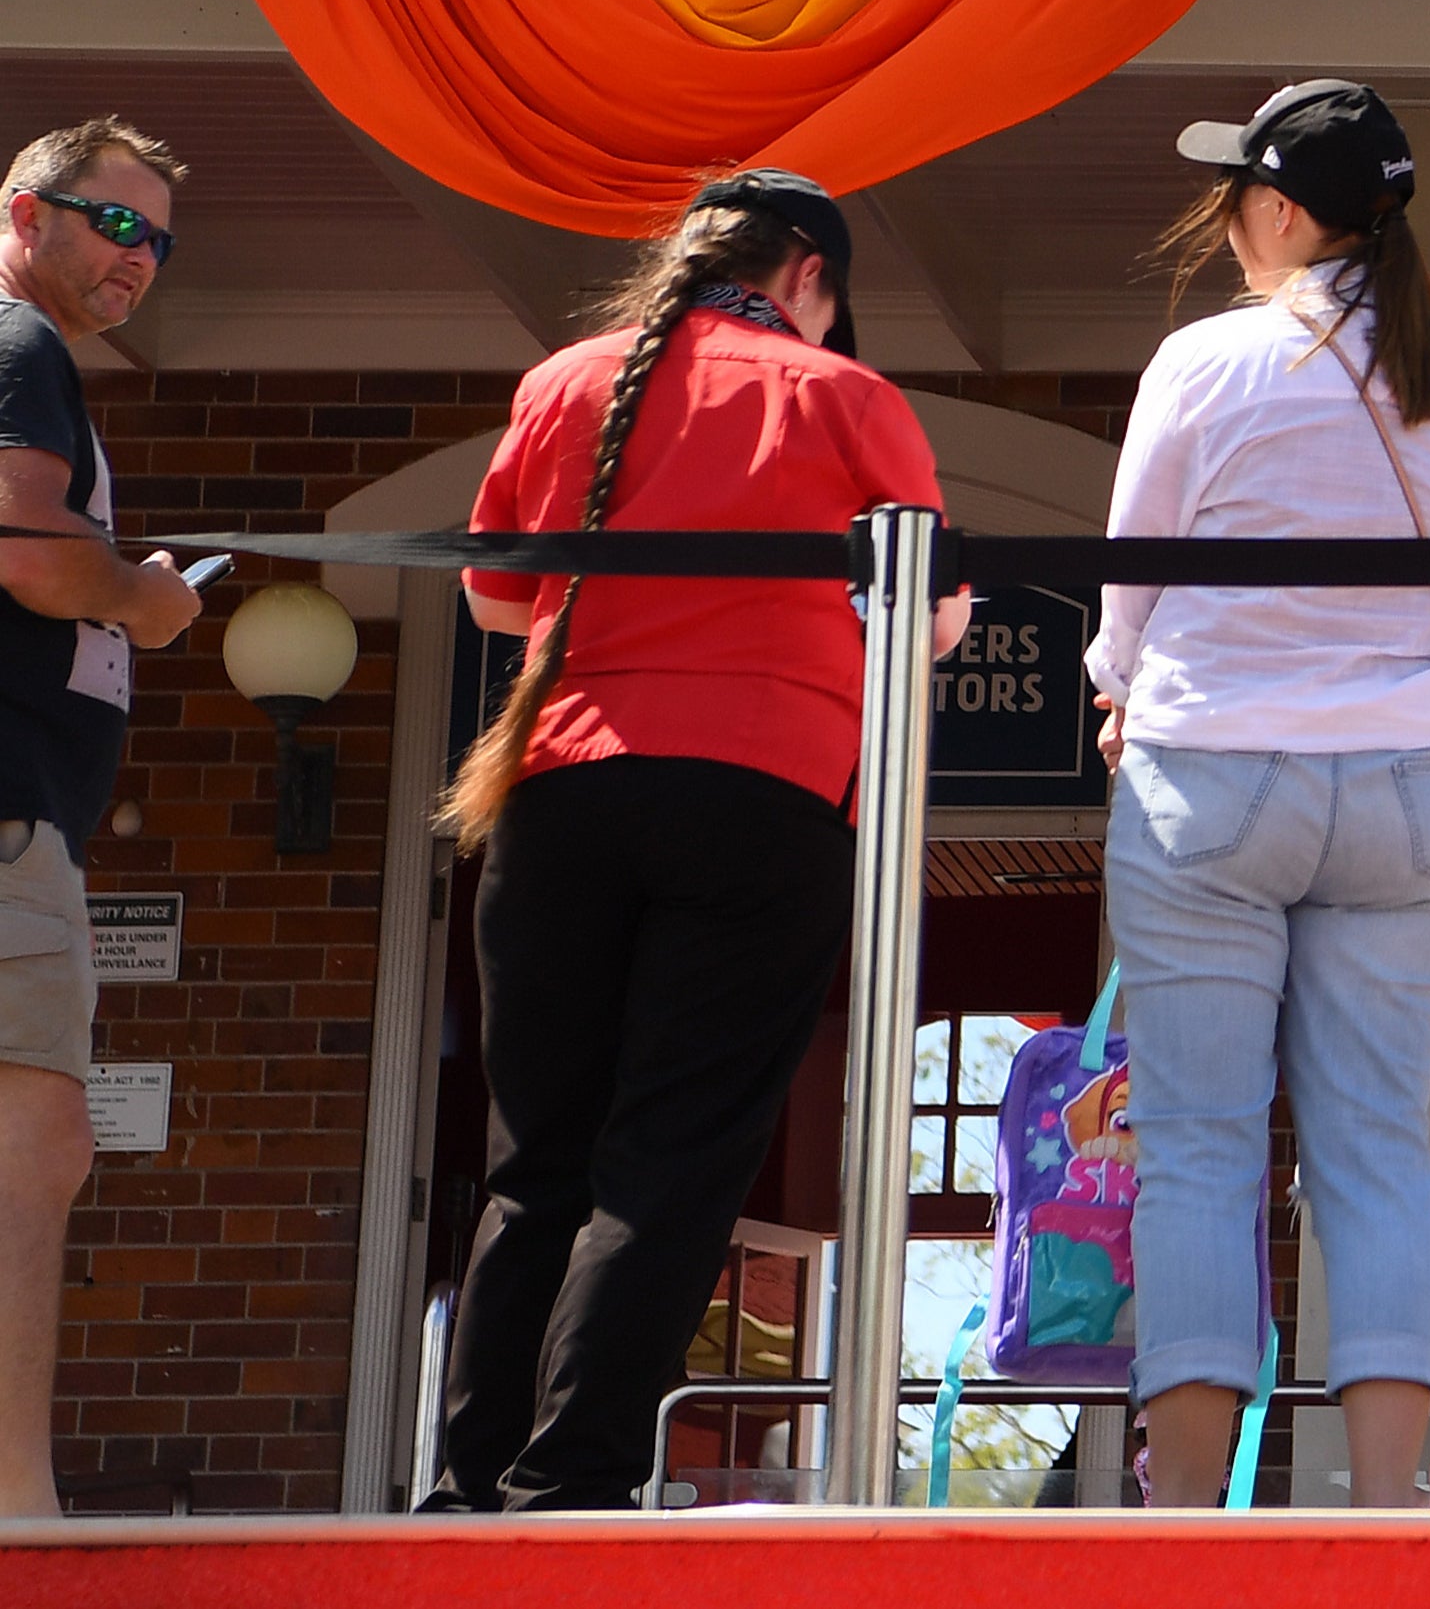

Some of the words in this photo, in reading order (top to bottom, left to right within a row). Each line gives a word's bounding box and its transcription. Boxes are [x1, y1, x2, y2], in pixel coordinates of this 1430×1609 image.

[122, 905, 171, 920] NOTICE
[128, 932, 168, 943] UNDER
[104, 946, 137, 956] HOUR
